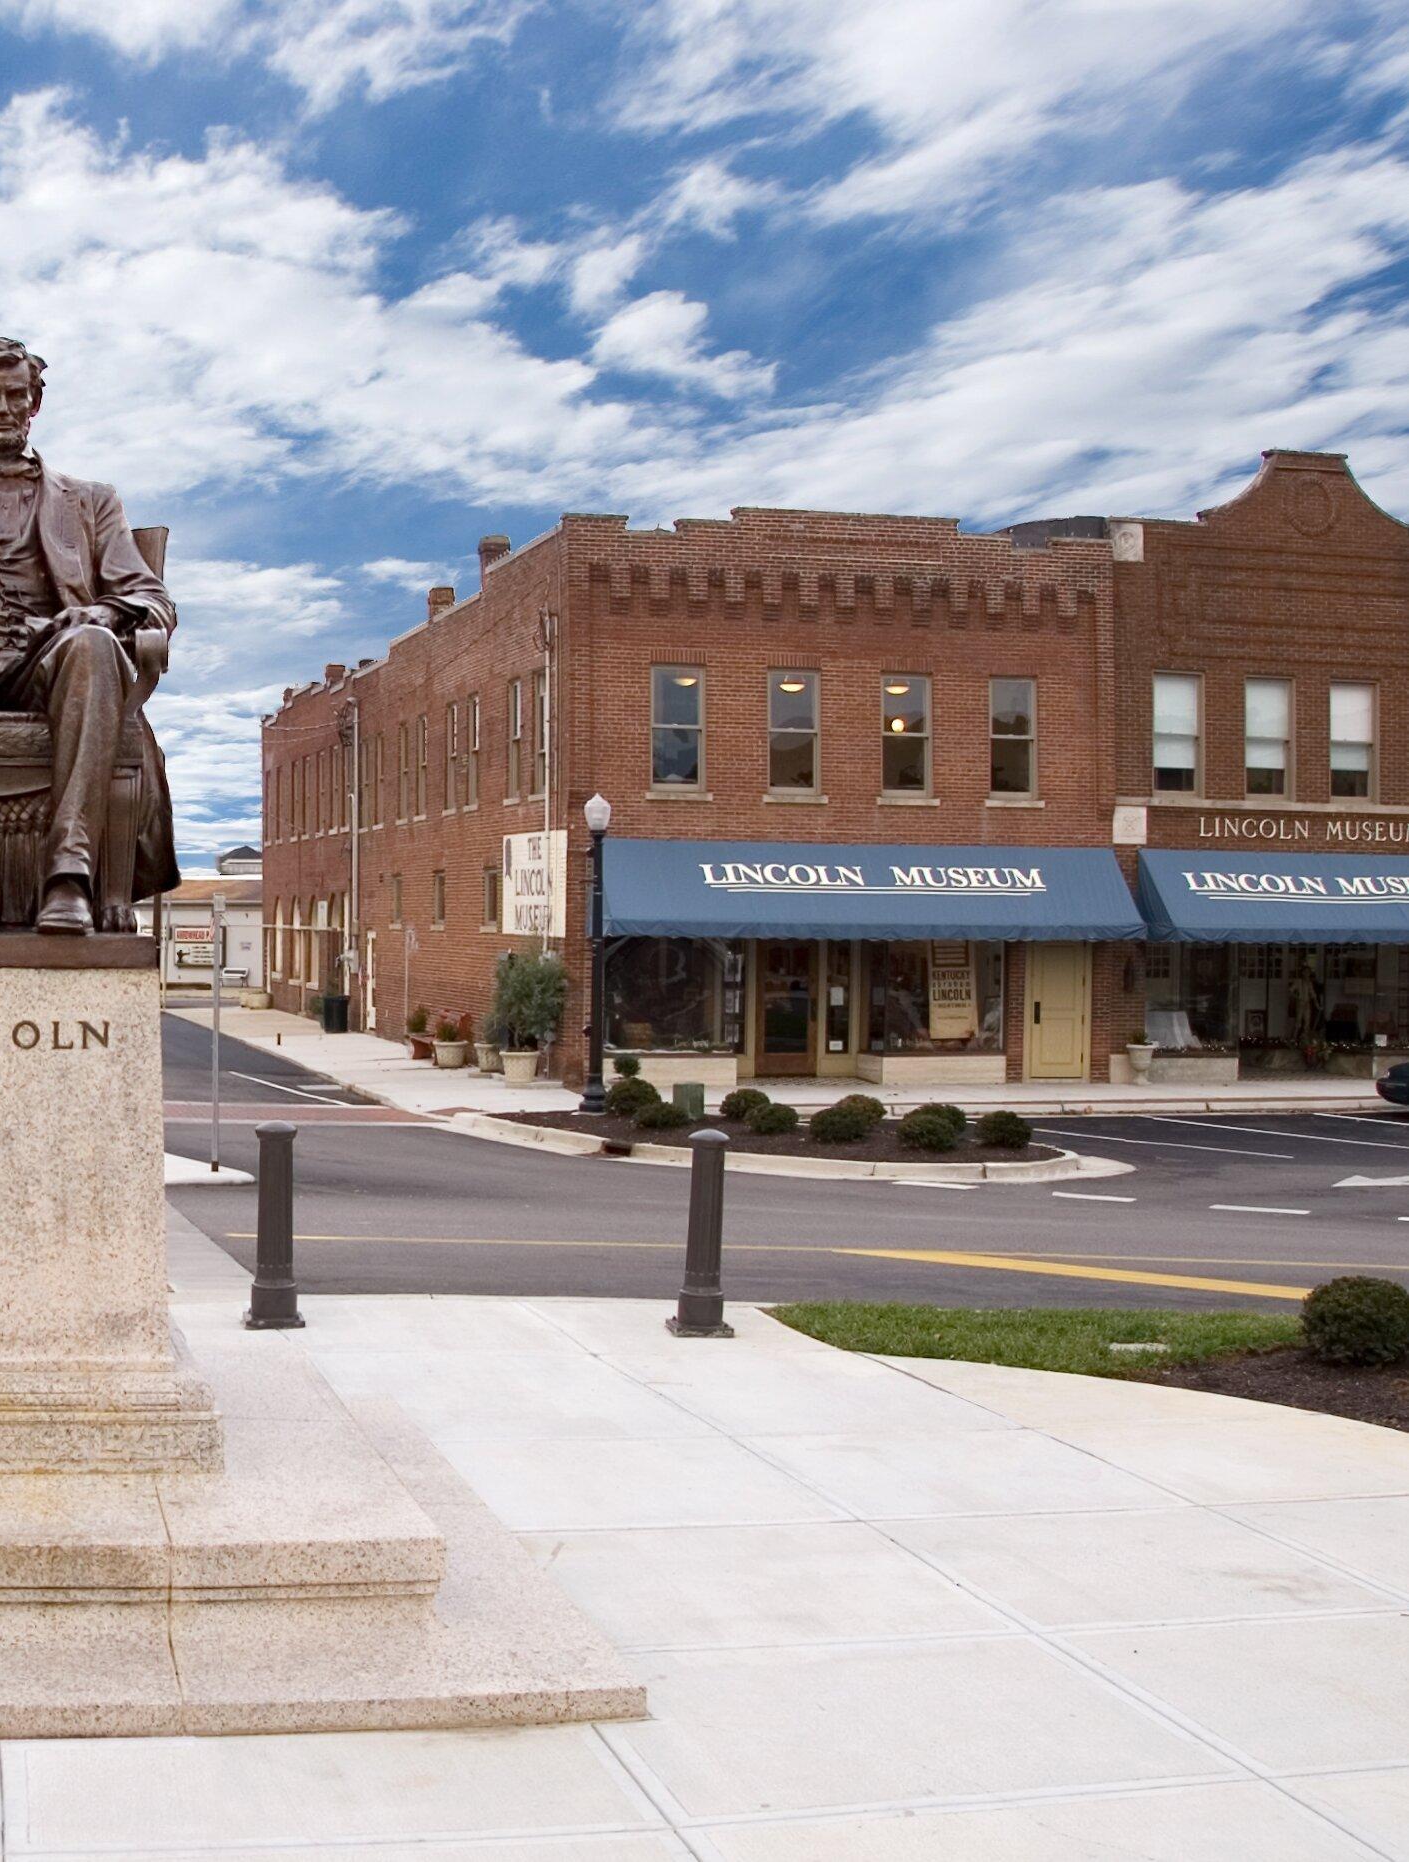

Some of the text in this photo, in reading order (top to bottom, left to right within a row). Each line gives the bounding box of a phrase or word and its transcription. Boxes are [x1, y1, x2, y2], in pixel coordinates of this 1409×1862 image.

[1199, 817, 1409, 843] LINCOLN MUSEU
[528, 836, 542, 859] THE
[699, 863, 1047, 889] LINCOLN MUSEUM
[1182, 871, 1328, 895] LINCOLN
[515, 904, 552, 931] MUSEUM
[932, 971, 969, 980] KENTUCKY
[933, 989, 971, 1001] LINCOLN
